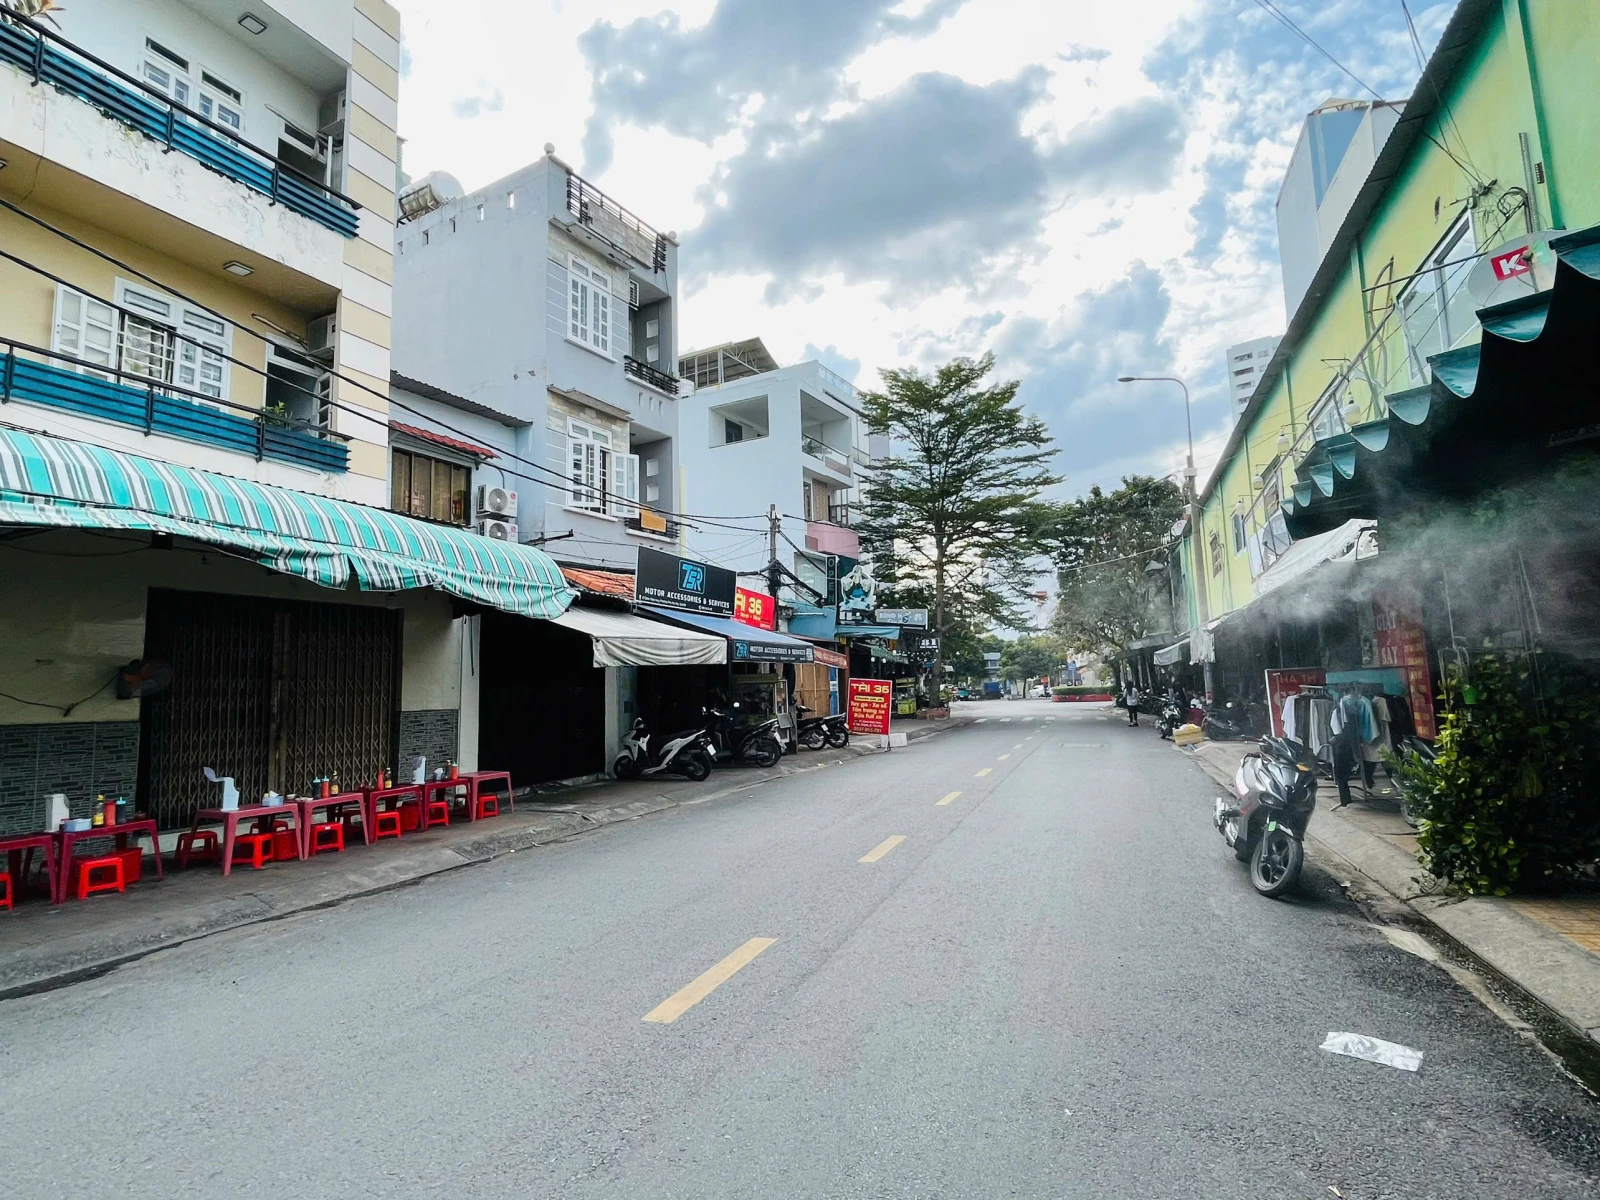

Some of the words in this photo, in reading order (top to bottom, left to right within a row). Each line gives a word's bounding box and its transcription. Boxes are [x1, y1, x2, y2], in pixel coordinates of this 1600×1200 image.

[645, 586, 665, 597] MOTOR
[667, 591, 702, 604] ACCESSORIES
[709, 599, 729, 608] SERVICES
[735, 589, 746, 612] ÀI
[749, 596, 762, 615] 36
[851, 682, 870, 692] TÀI
[874, 685, 889, 694] 36
